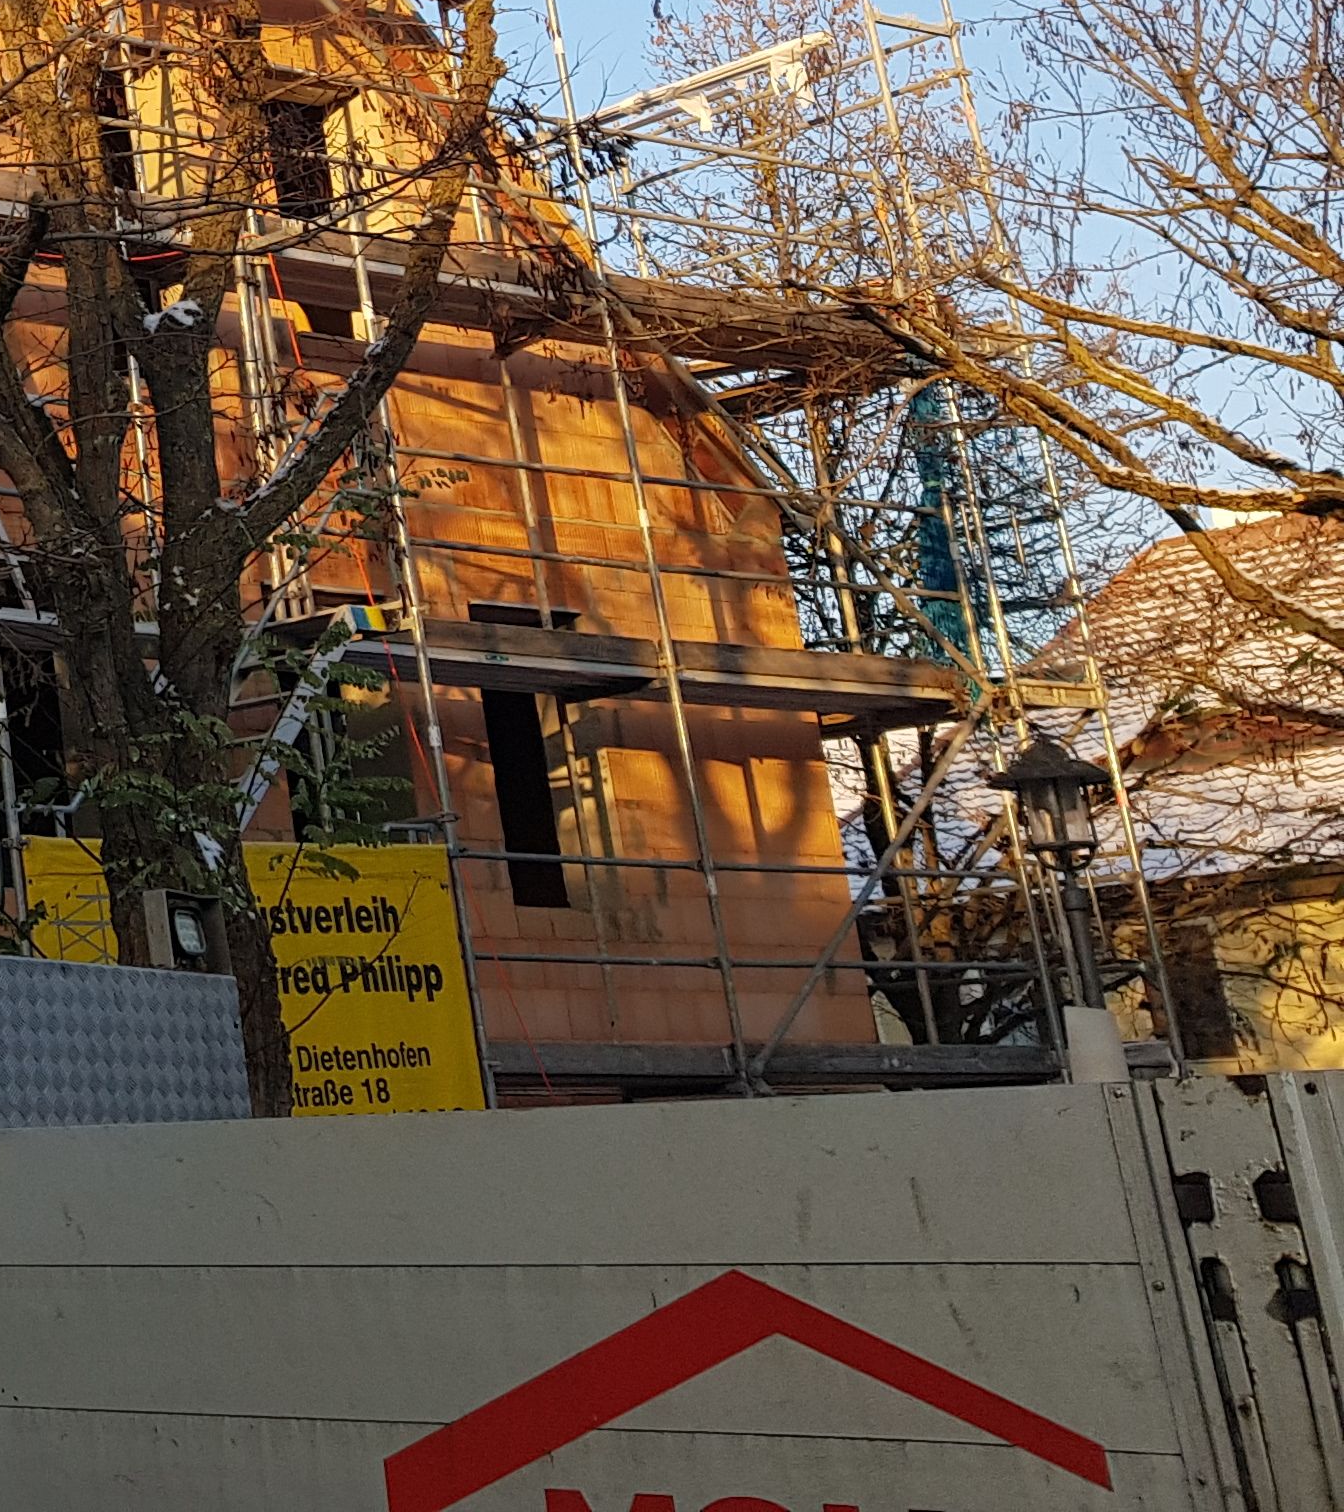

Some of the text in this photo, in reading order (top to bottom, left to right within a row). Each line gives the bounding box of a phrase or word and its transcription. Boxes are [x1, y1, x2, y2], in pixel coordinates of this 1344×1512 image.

[340, 955, 443, 1002] Philipp
[296, 1041, 432, 1072] Dietenhofen
[361, 1077, 391, 1104] 18
